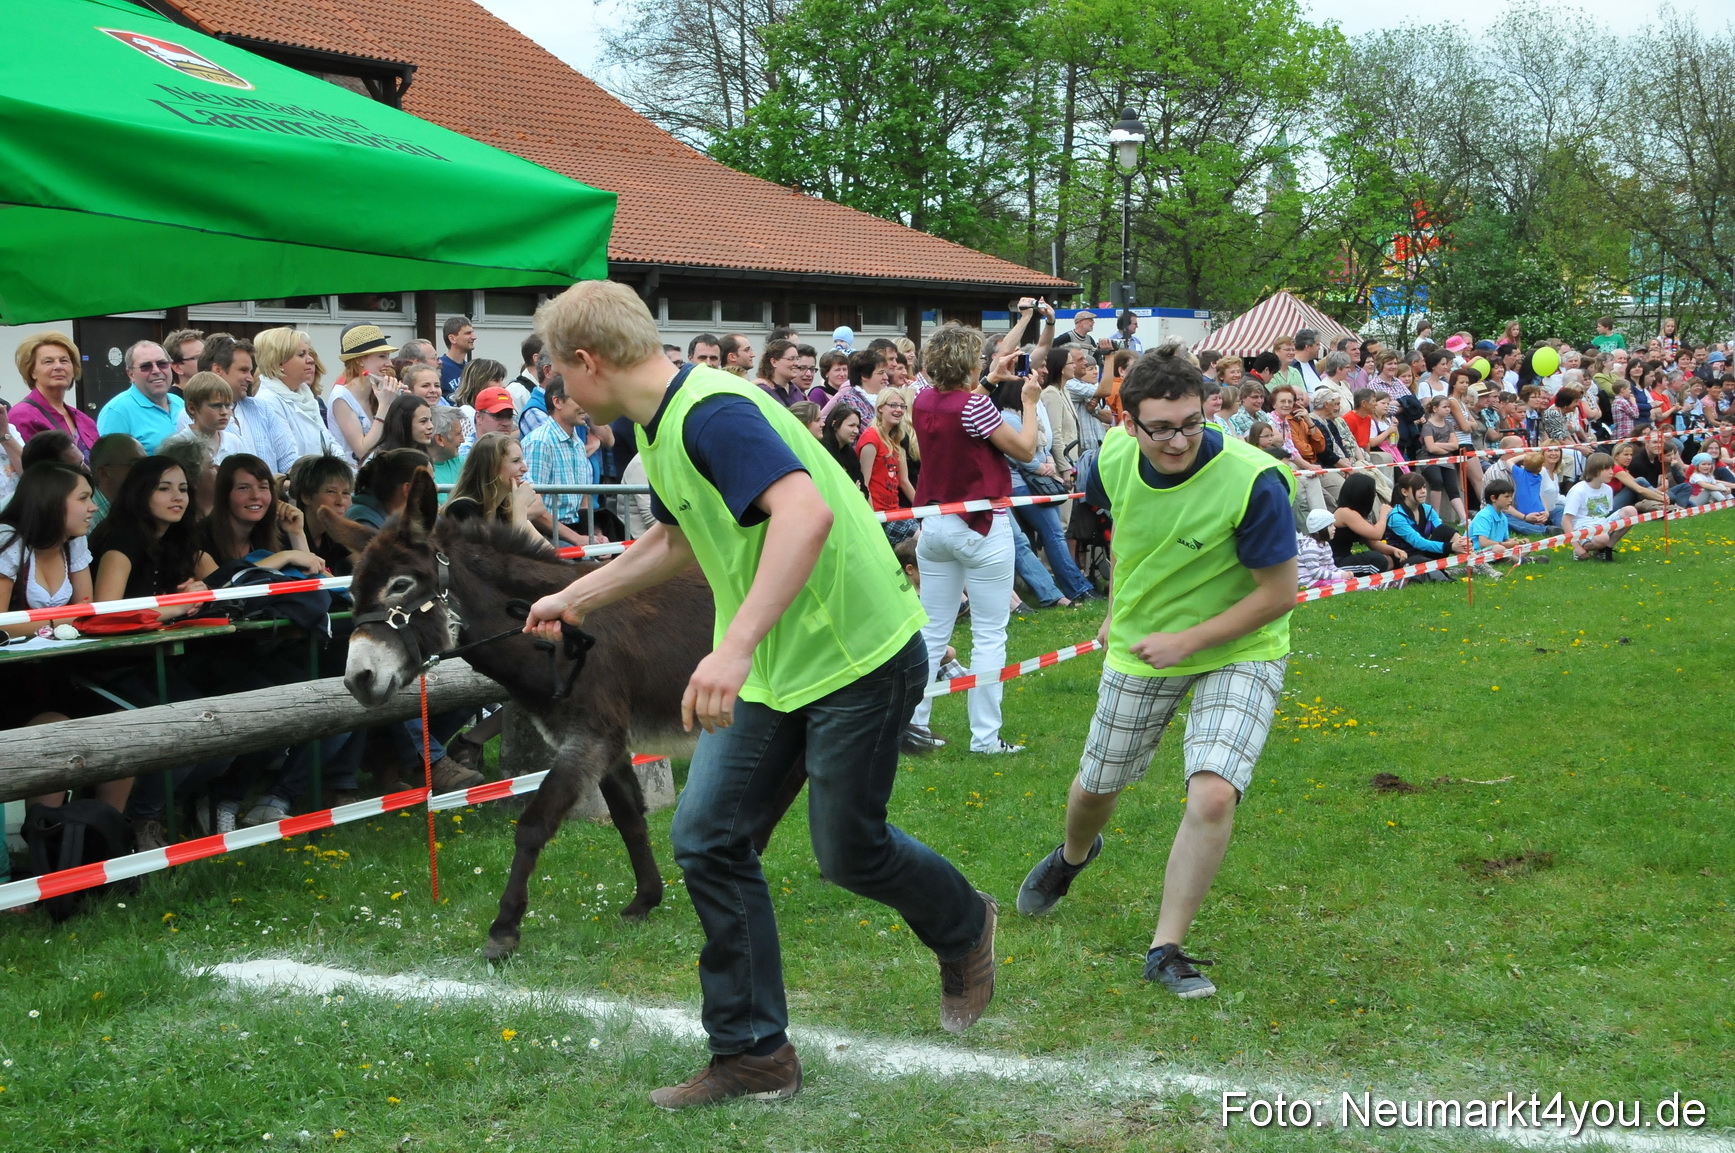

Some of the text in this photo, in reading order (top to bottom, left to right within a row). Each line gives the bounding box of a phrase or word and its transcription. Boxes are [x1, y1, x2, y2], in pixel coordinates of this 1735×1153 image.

[146, 98, 452, 163] Lammsbräu
[152, 83, 369, 131] Neumarkter
[1176, 537, 1196, 550] JAKO
